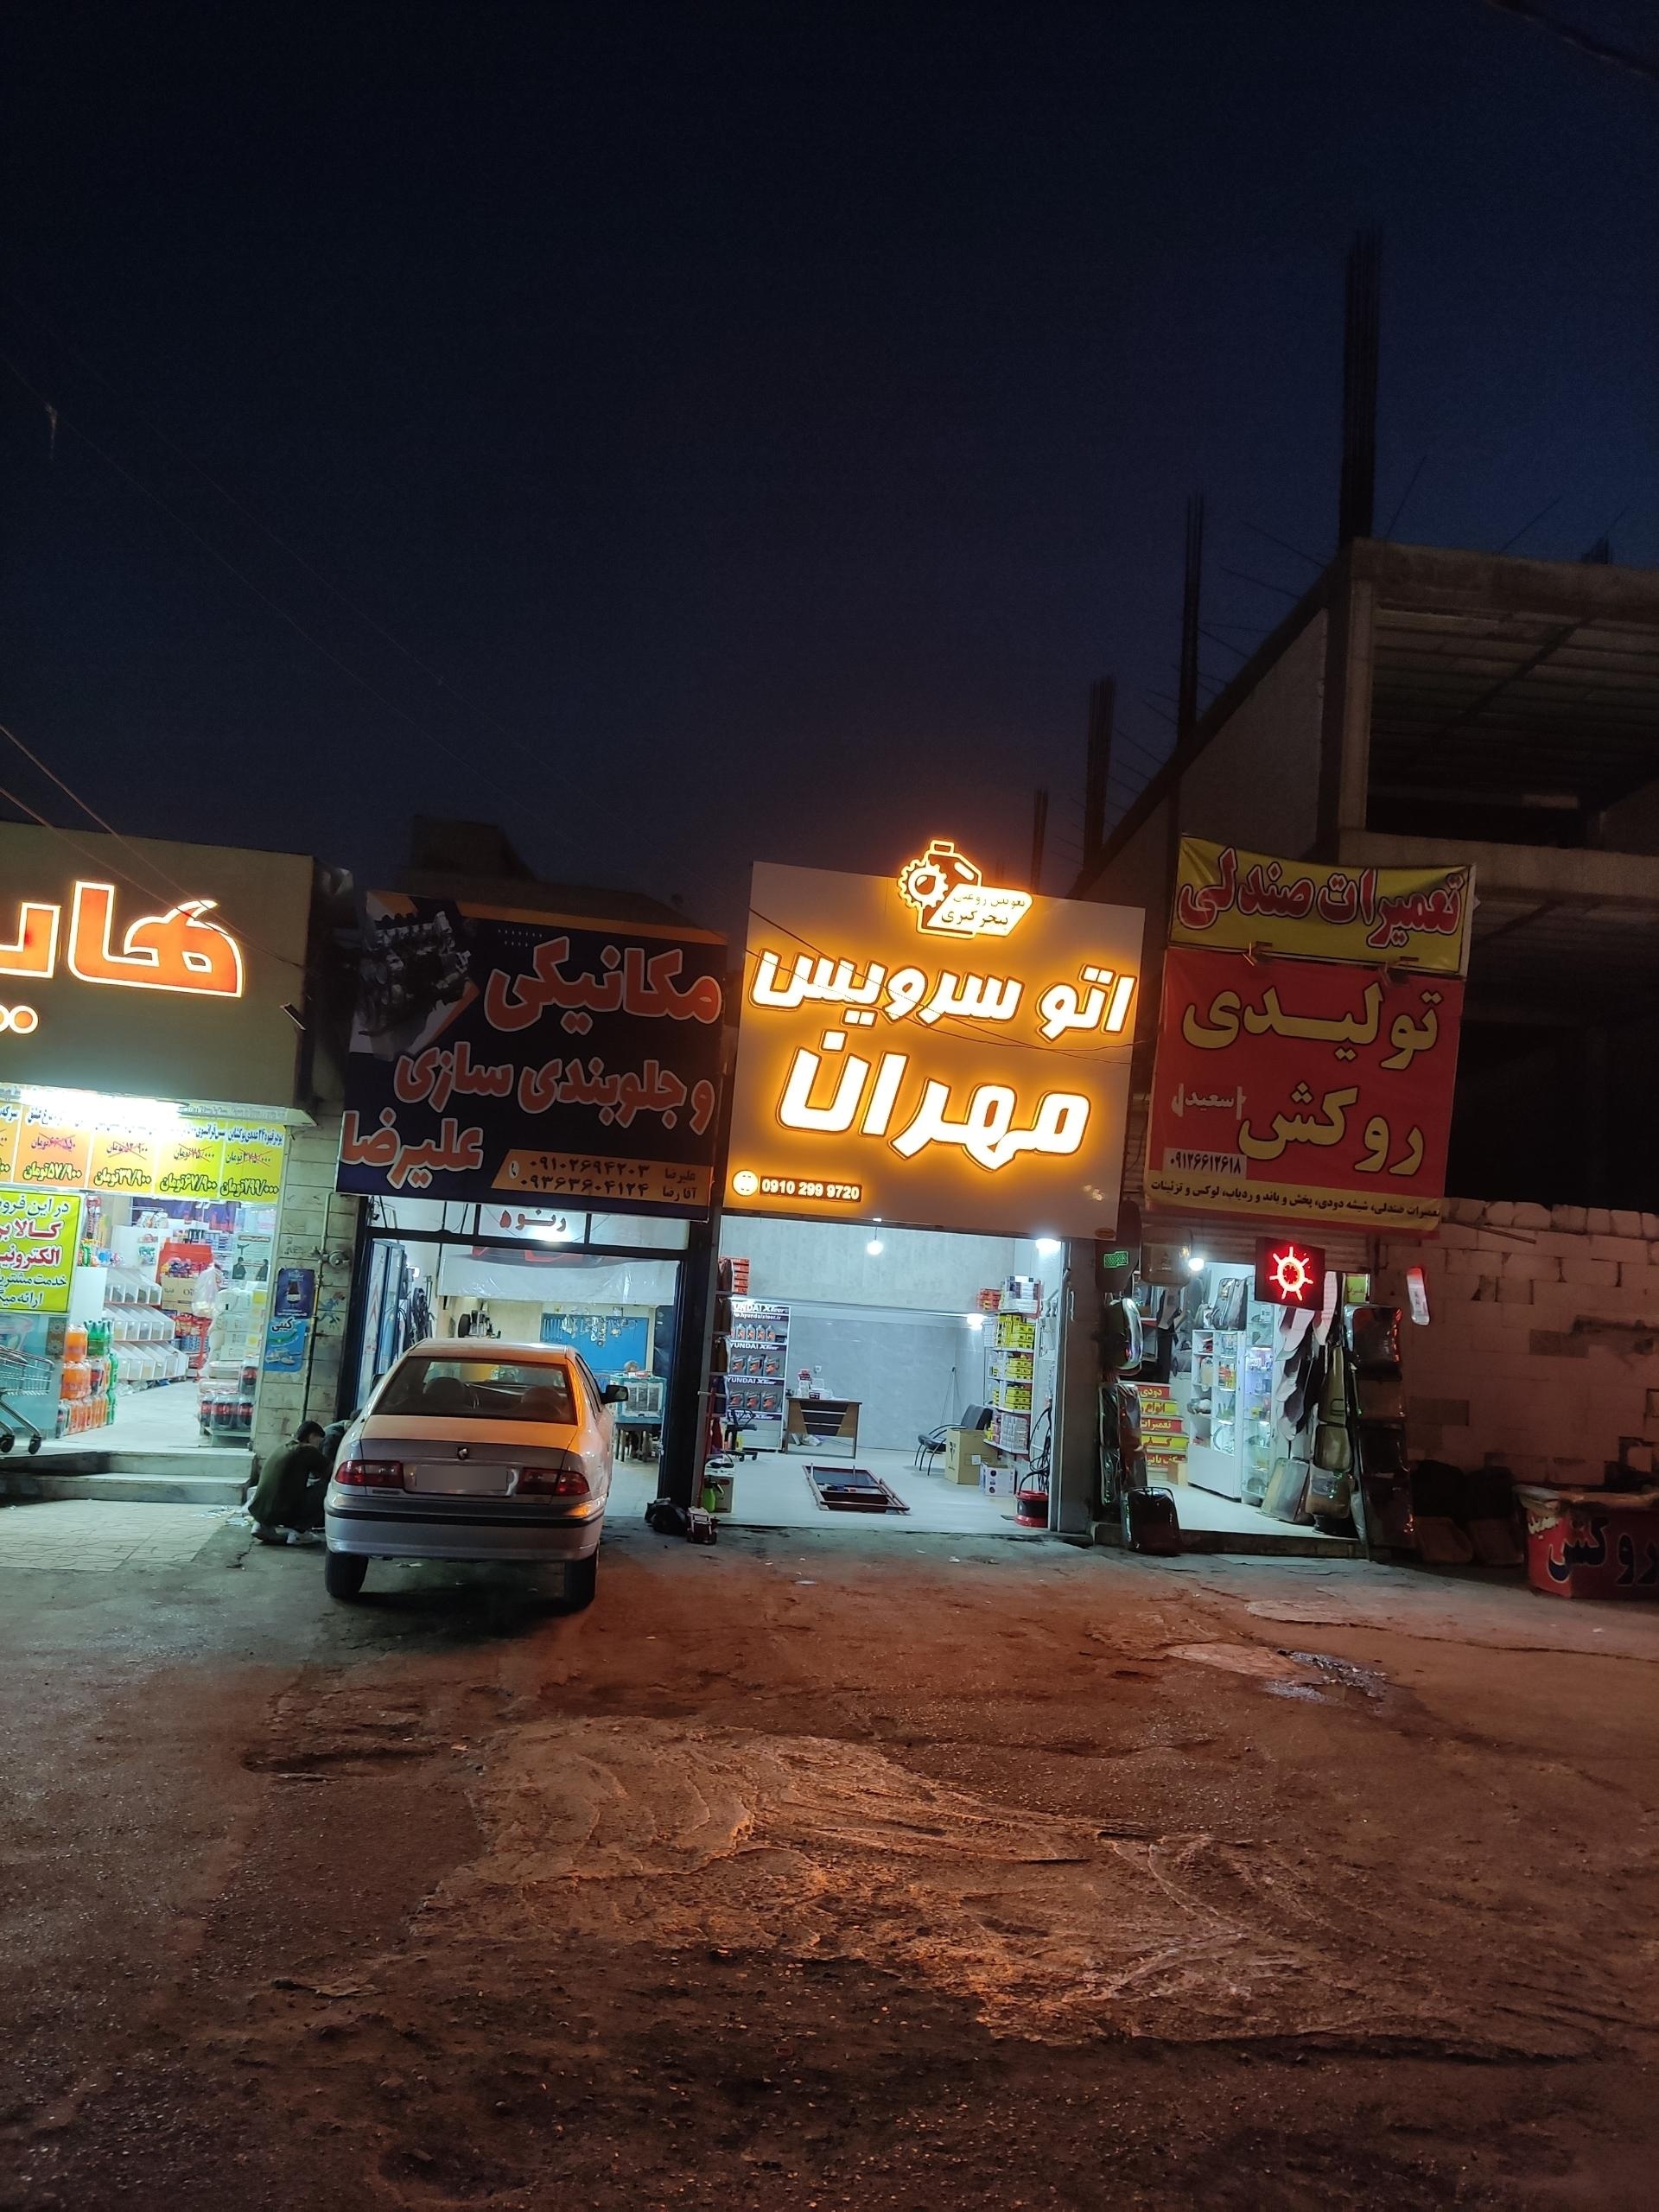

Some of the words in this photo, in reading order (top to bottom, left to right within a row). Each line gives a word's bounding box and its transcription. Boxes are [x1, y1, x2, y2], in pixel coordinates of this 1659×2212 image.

[1177, 846, 1314, 930] صندلی
[1317, 868, 1464, 948] تعمیرات
[484, 936, 722, 1035] مکانیکی
[747, 948, 1024, 1027] سرویس
[1036, 963, 1136, 1042] اتو
[1182, 982, 1443, 1071] تولیدی
[393, 1040, 514, 1113] سازی
[517, 1057, 688, 1130] جلوبندی
[776, 1028, 1091, 1173] مهران
[341, 1107, 483, 1189] علیرضا
[1237, 1081, 1426, 1177] روکش
[0, 1195, 26, 1215] فرو
[27, 1198, 52, 1217] این
[54, 1202, 69, 1217] در
[761, 1179, 796, 1195] 0910
[798, 1181, 824, 1198] 299
[826, 1184, 861, 1201] 9720
[14, 1219, 62, 1238] کالا
[33, 1274, 67, 1287] خدمت
[1140, 1388, 1162, 1398] دودی
